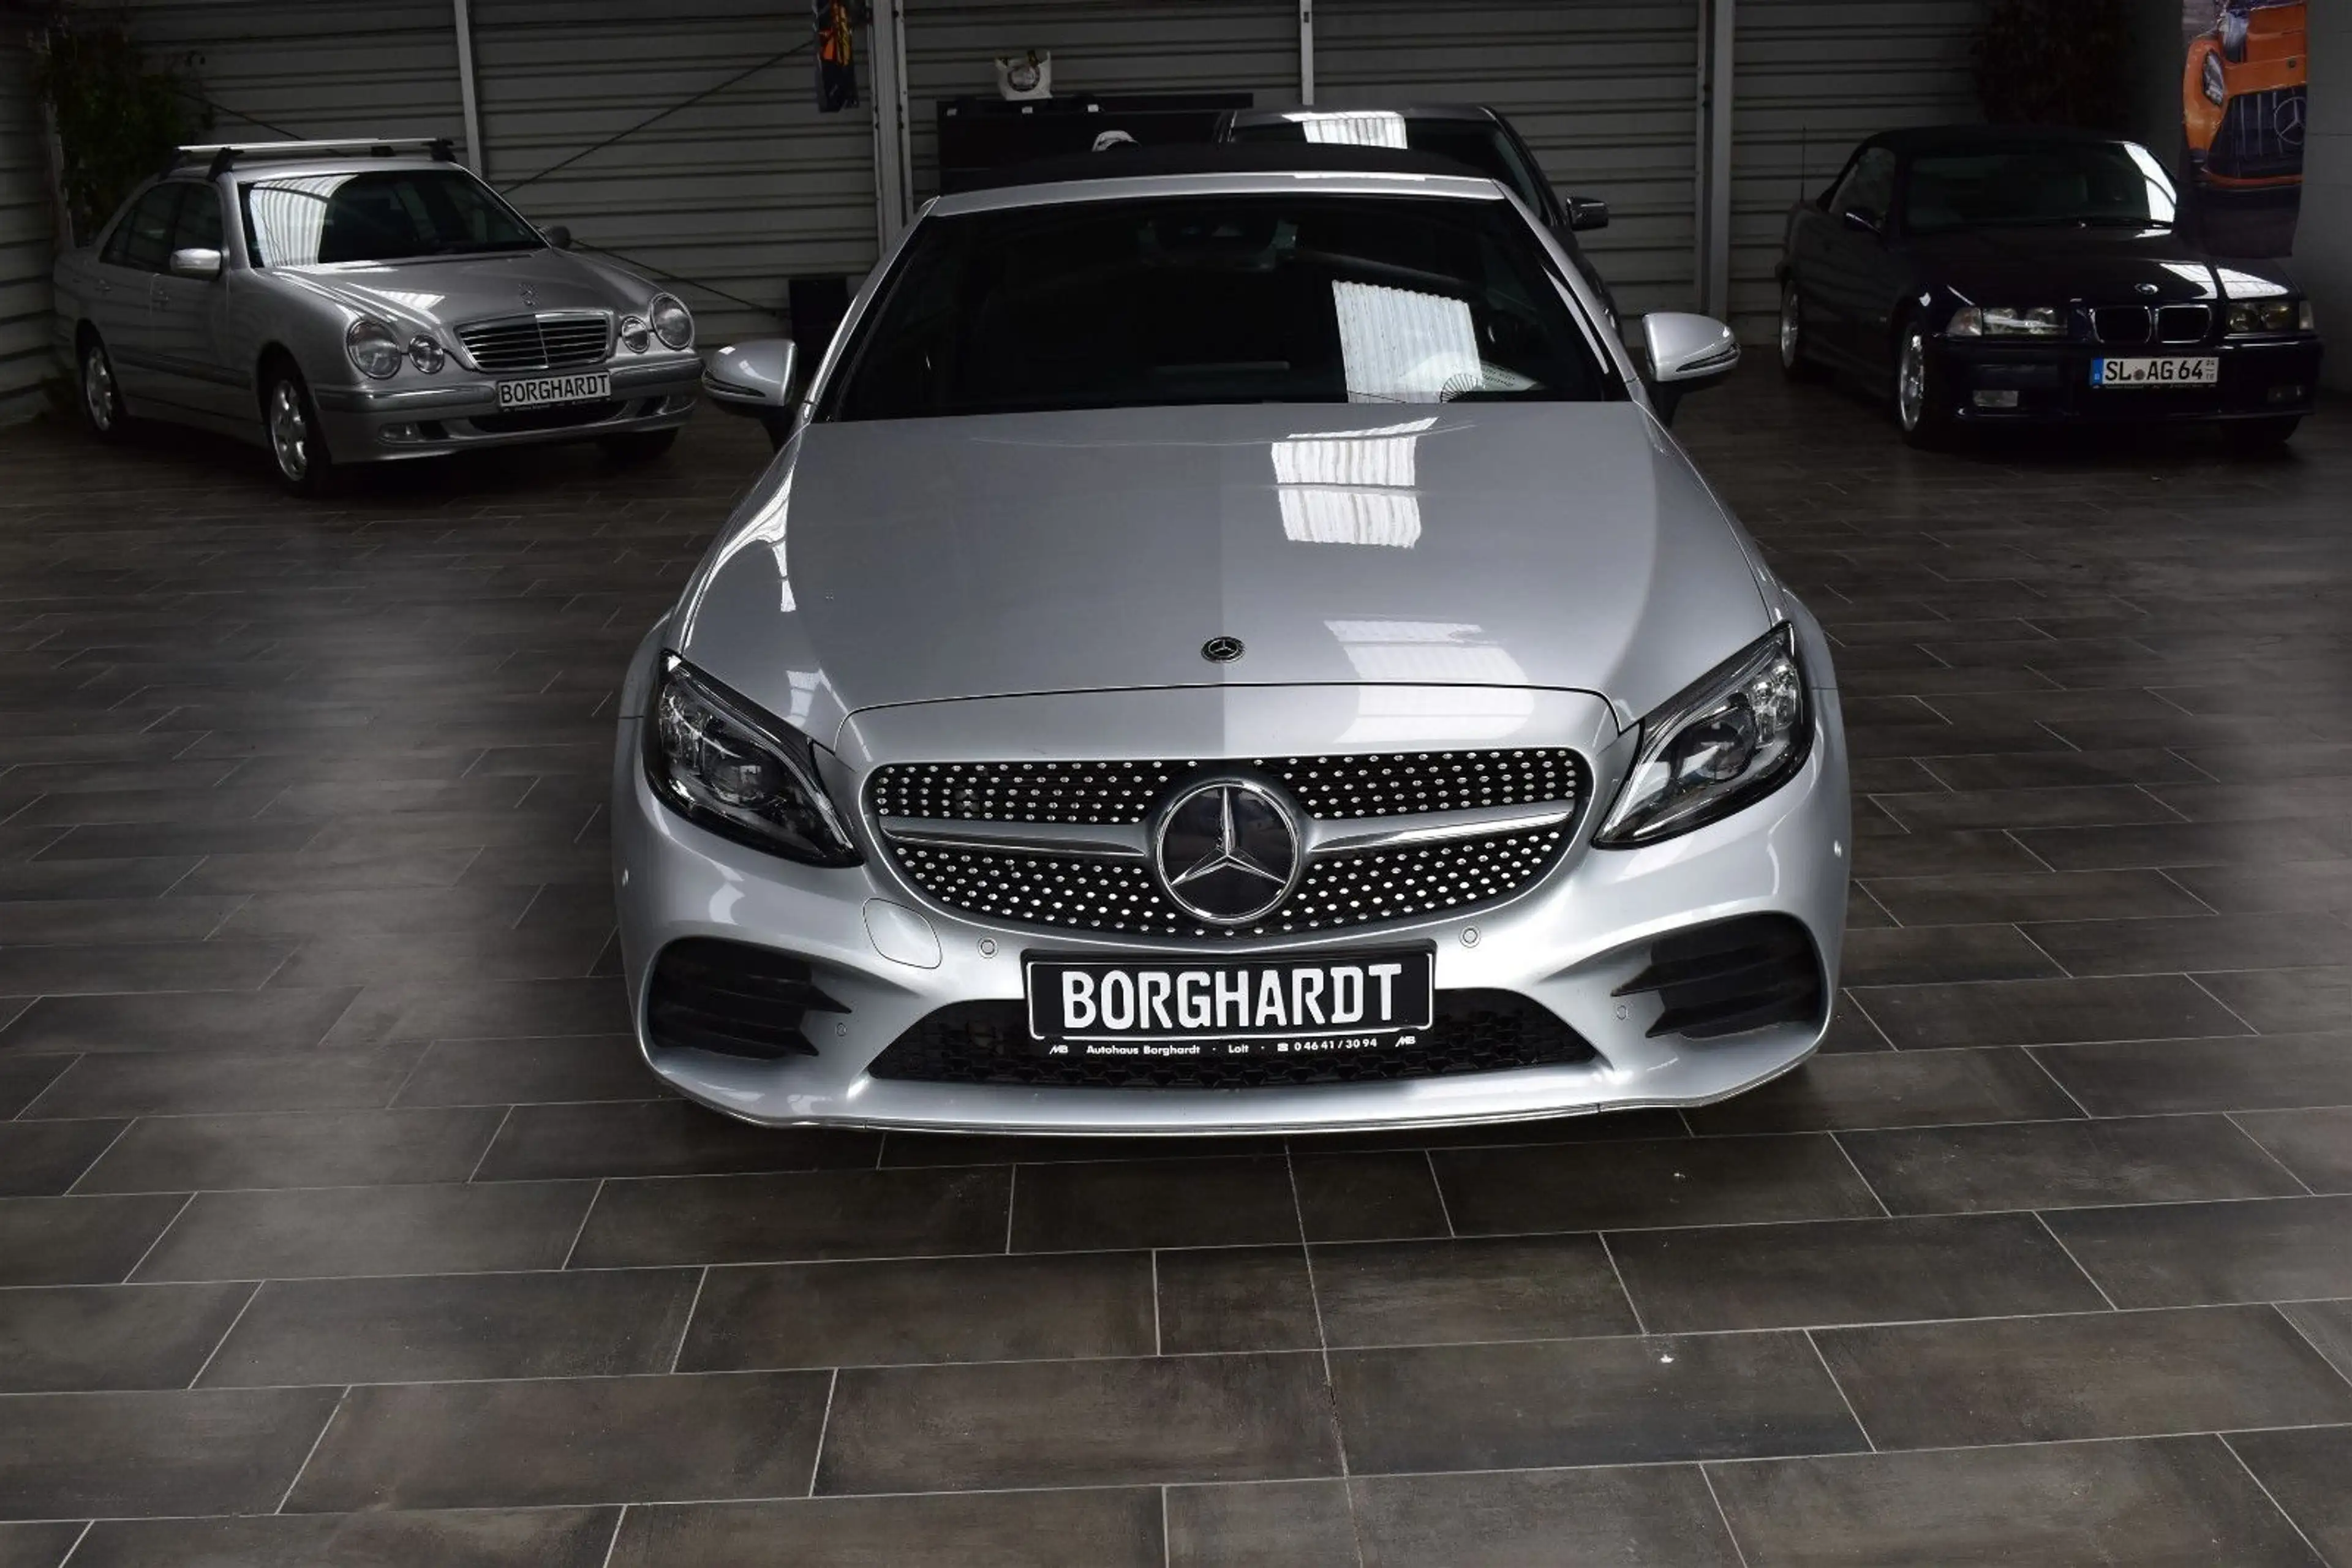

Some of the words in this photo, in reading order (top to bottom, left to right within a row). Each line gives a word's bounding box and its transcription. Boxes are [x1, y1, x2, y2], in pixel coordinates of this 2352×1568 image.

[2105, 360, 2132, 381] SL
[2146, 360, 2174, 380] AG
[2178, 360, 2203, 380] 64
[501, 375, 608, 403] BORGHARDT
[1062, 963, 1402, 1030] BORGHARDT
[1086, 1044, 1139, 1055] Autohaus
[1143, 1044, 1200, 1056] Borghardt
